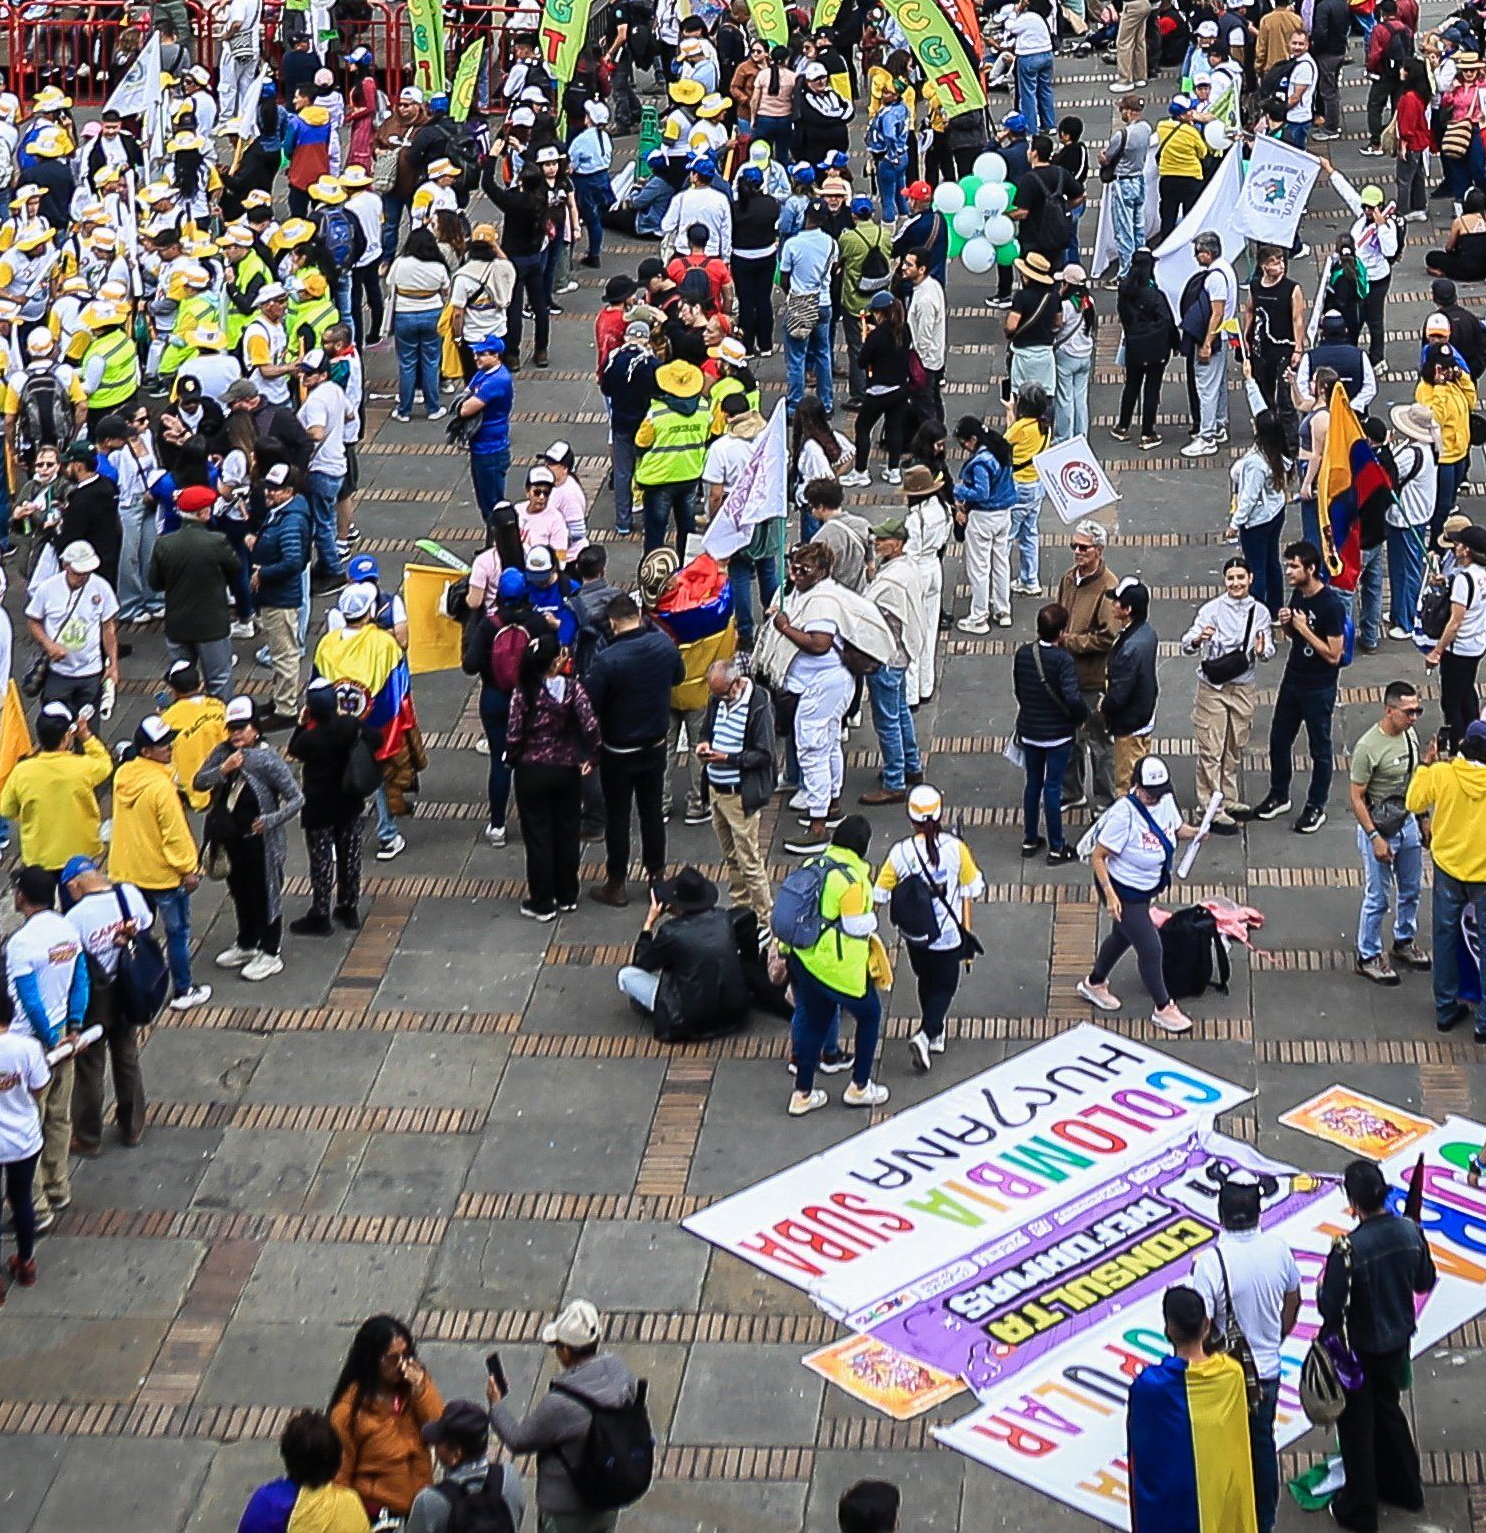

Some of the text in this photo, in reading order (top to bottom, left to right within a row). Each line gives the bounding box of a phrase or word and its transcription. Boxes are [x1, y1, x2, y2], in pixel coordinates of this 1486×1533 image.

[896, 1, 967, 105] CGT
[849, 1042, 1145, 1193] HUMANA
[903, 1069, 1226, 1229] COLOMBIA
[736, 1188, 916, 1279] SUBA
[944, 1193, 1181, 1320] REFORMAS
[984, 1215, 1217, 1346] CONSULTA
